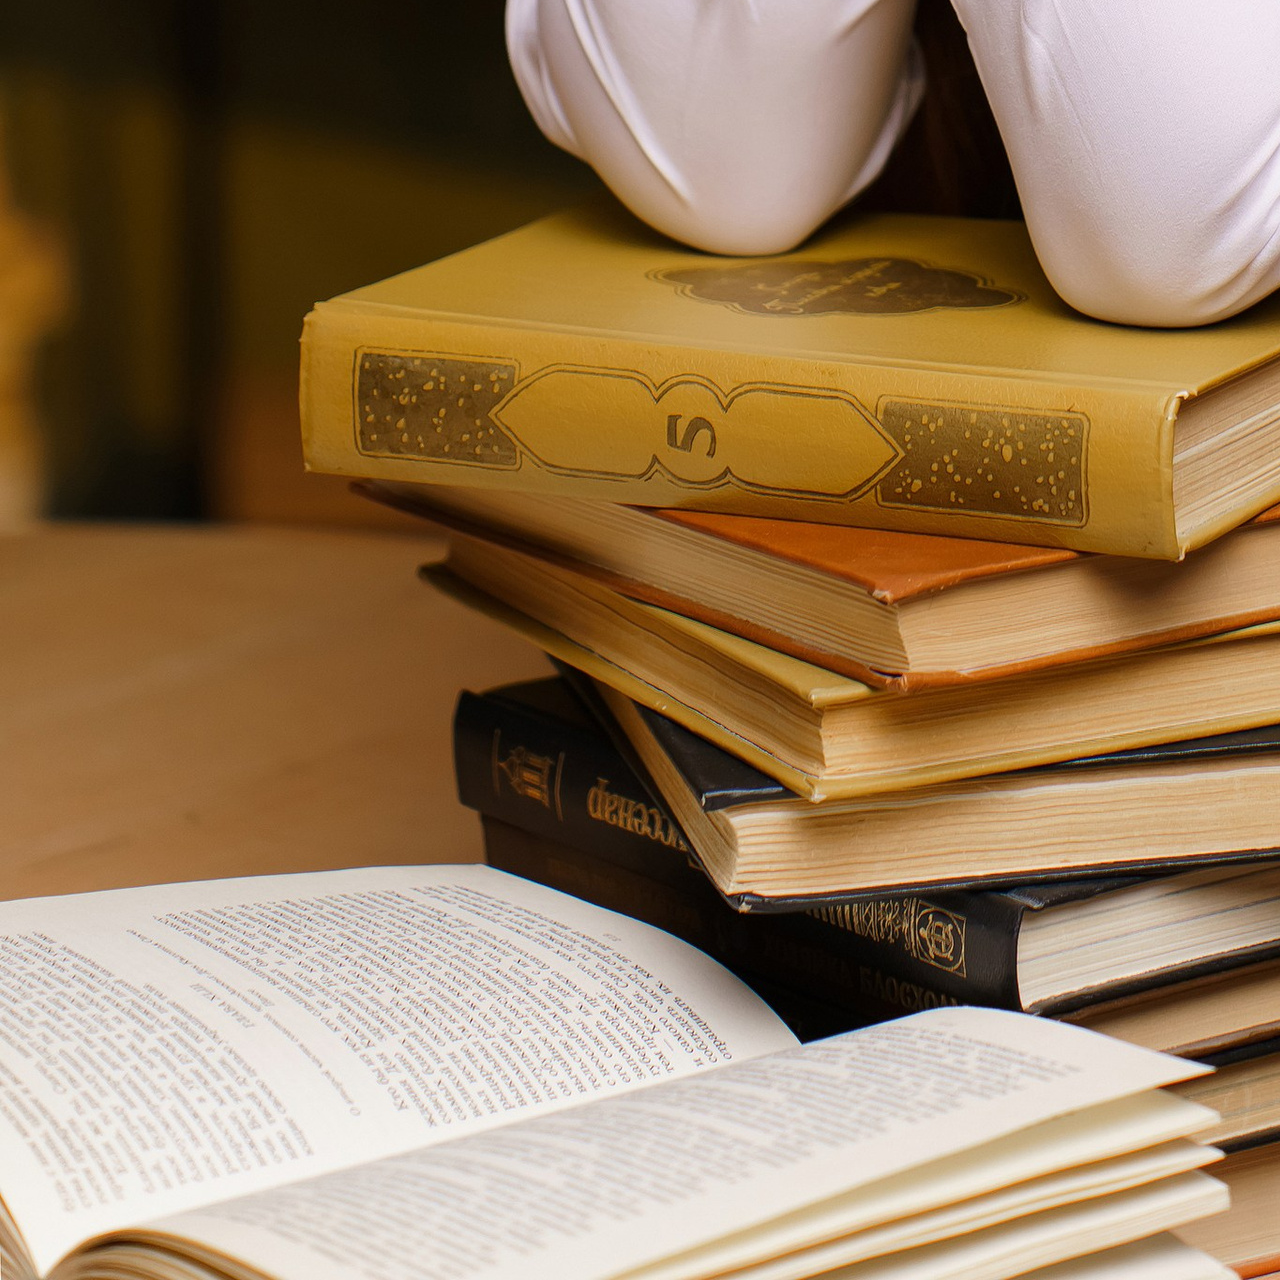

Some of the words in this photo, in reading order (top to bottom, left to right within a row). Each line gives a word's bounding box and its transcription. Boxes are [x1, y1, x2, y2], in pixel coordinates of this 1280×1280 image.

[667, 414, 717, 458] 5
[587, 777, 703, 870] ссенар
[380, 936, 427, 960] выказал
[400, 938, 434, 954] своей
[465, 941, 482, 950] он
[534, 931, 576, 951] прежде
[293, 960, 316, 973] как
[314, 950, 345, 967] когда
[377, 945, 418, 966] второй
[425, 961, 442, 970] он
[483, 951, 502, 963] что
[512, 958, 530, 968] их
[552, 950, 575, 961] как
[576, 952, 591, 961] то
[580, 943, 616, 965] стричь
[611, 951, 632, 963] это
[332, 972, 357, 985] раз
[347, 969, 384, 994] только
[400, 968, 420, 980] его
[415, 966, 463, 997] касается
[443, 971, 472, 991] здесь
[449, 954, 513, 994] наивысшей
[508, 964, 538, 986] было,
[576, 962, 600, 980] того,
[594, 962, 628, 988] Санчо,
[630, 964, 654, 979] как
[352, 986, 368, 995] не
[385, 983, 404, 994] же
[432, 954, 528, 1019] рассудительности
[471, 992, 486, 1002] то
[491, 967, 550, 1010] вниманием
[541, 977, 574, 998] дабы
[550, 970, 600, 1007] протекло
[623, 973, 663, 1005] чистоту
[655, 980, 672, 994] их,
[858, 966, 956, 1009] БЛОСХО
[277, 985, 322, 1016] слышал
[315, 1000, 332, 1009] не
[421, 997, 459, 1023] ясный
[428, 985, 495, 1039] расходились
[461, 998, 480, 1011] же
[511, 994, 529, 1005] до
[539, 988, 572, 1014] видно
[575, 1001, 592, 1016] их,
[600, 980, 660, 1033] Касательно
[632, 990, 658, 1013] себя,
[217, 1001, 255, 1028] ГЛАВА
[319, 1017, 341, 1032] кто
[366, 996, 410, 1029] истории
[402, 995, 462, 1042] рассуждая
[477, 1011, 496, 1028] что
[488, 1003, 522, 1035] Санчо,
[524, 1006, 562, 1036] дошел
[595, 991, 657, 1048] продолжал:
[336, 1012, 375, 1048] Кихота,
[456, 1025, 477, 1039] ум
[529, 1027, 541, 1035] и
[658, 1016, 693, 1053] самого
[666, 1006, 717, 1062] соблюдать
[673, 996, 731, 1059] отращивать
[406, 1030, 444, 1064] нашей
[548, 1012, 609, 1076] неослабным
[595, 1020, 645, 1079] запомнить
[599, 1009, 660, 1075] губернатора
[358, 1053, 374, 1066] из
[376, 1052, 400, 1073] Дон
[398, 1038, 434, 1074] благих
[446, 1051, 476, 1083] нести
[521, 1037, 558, 1076] обучал
[538, 1036, 586, 1092] вычайное
[558, 1039, 601, 1089] тельстве
[653, 1050, 674, 1073] тем
[692, 1057, 704, 1067] и
[371, 1067, 389, 1085] бы
[460, 1044, 515, 1110] рыцарстве,
[472, 1040, 527, 1106] выказывал
[490, 1041, 542, 1103] неизменно
[613, 1063, 631, 1083] его
[387, 1086, 408, 1110] Кто
[394, 1052, 451, 1123] совершенно
[434, 1079, 466, 1120] самых
[439, 1066, 482, 1117] великой
[556, 1080, 572, 1096] он
[399, 1079, 437, 1127] ждения
[476, 1089, 497, 1114] нал
